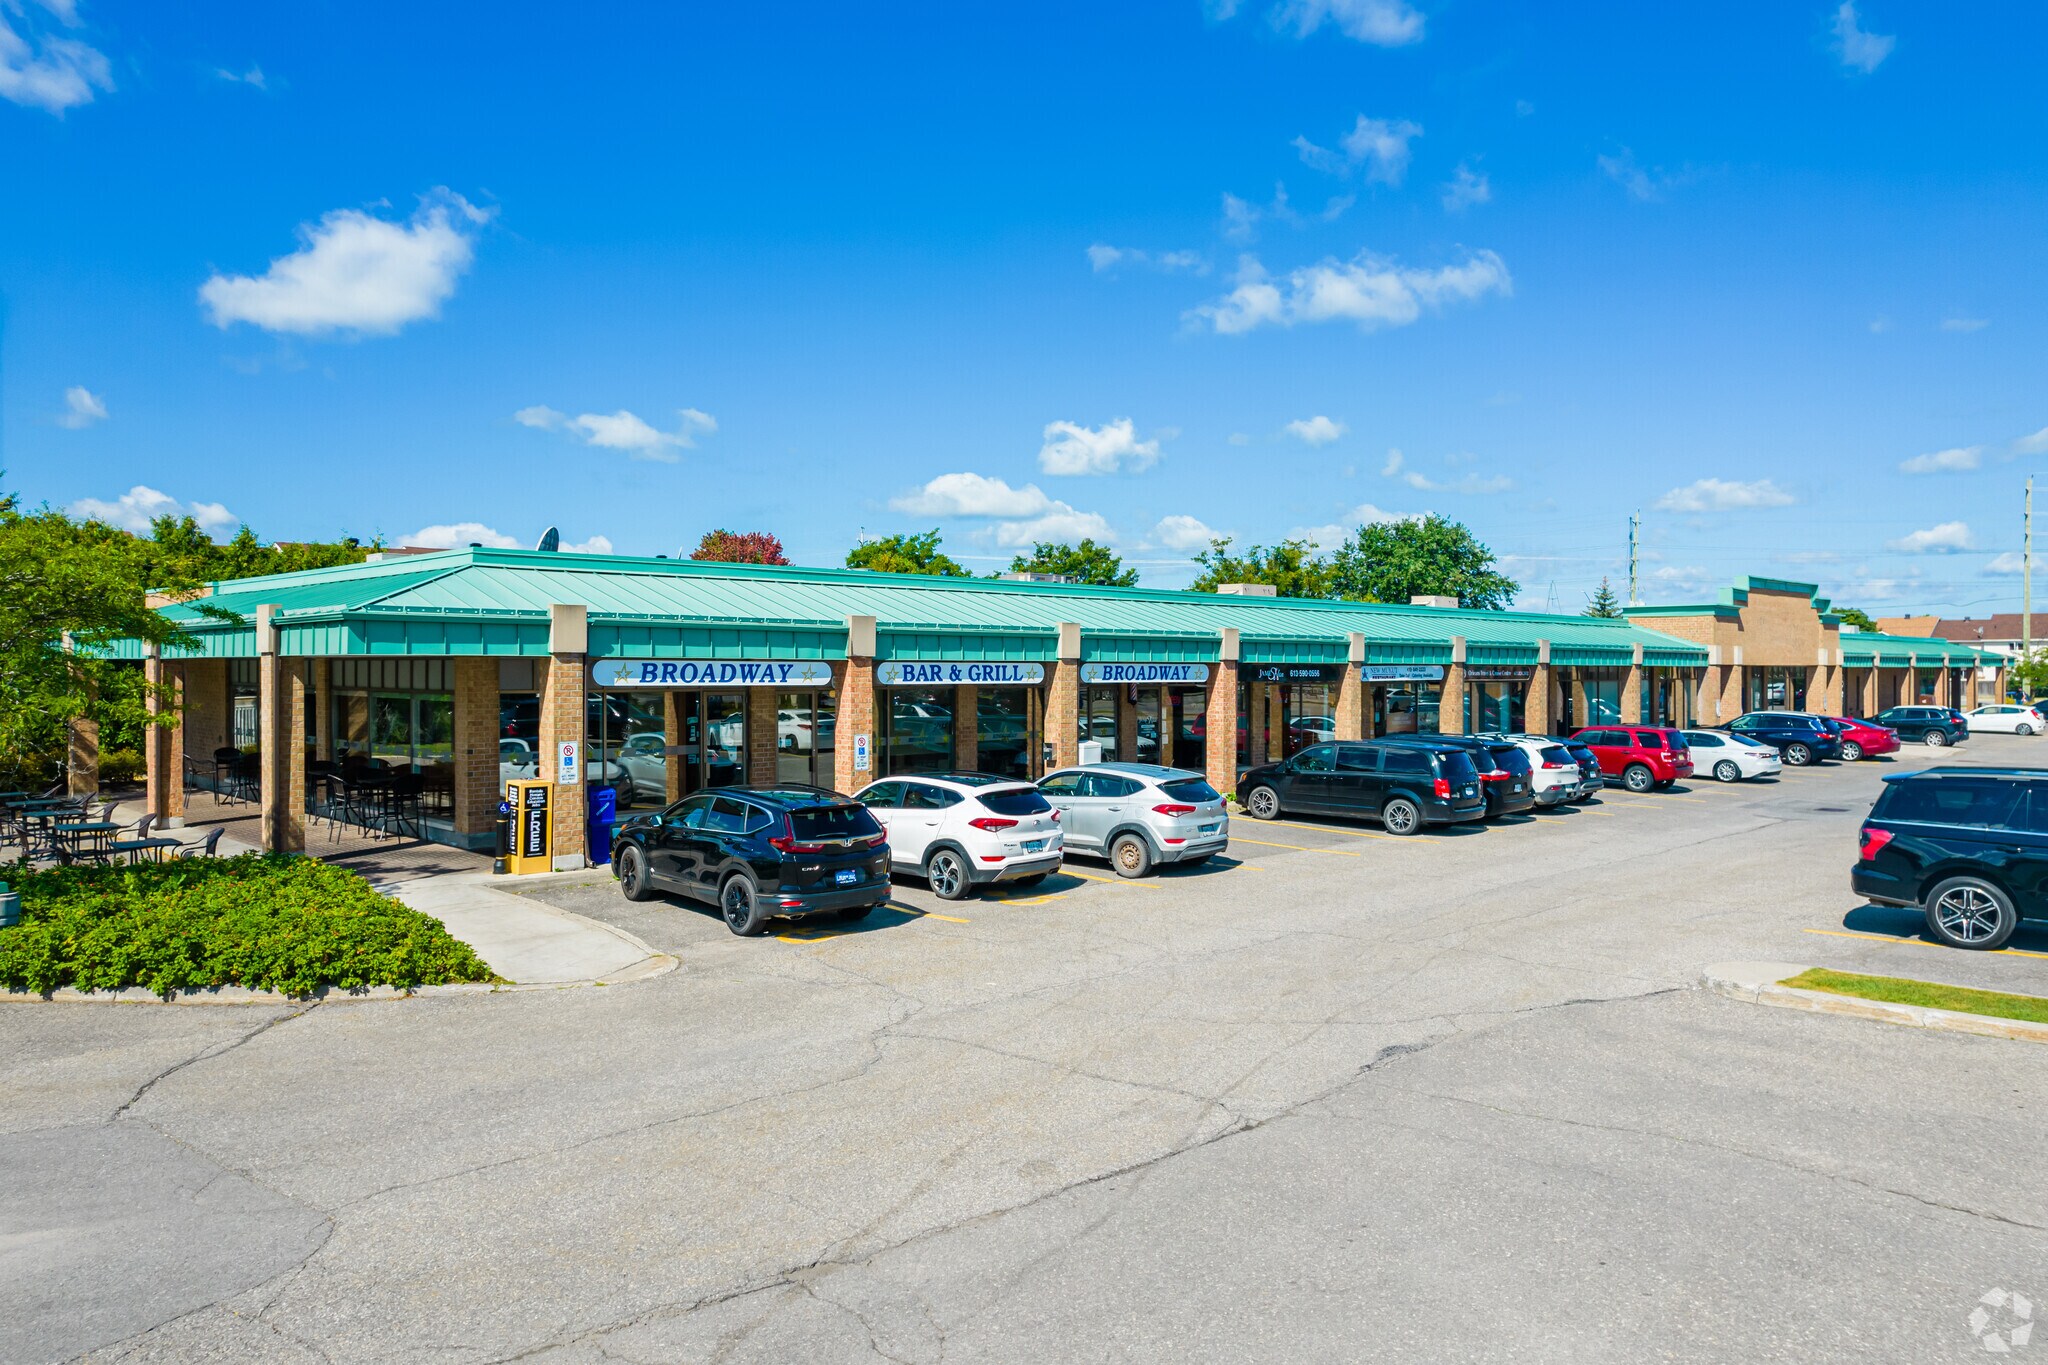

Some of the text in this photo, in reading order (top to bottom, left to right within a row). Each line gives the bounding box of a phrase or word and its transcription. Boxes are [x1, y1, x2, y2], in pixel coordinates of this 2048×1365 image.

[639, 662, 794, 684] BROADWAY
[902, 664, 1024, 682] BAR & GRILL
[1101, 665, 1191, 681] BROADWAY
[530, 811, 541, 852] FREE
